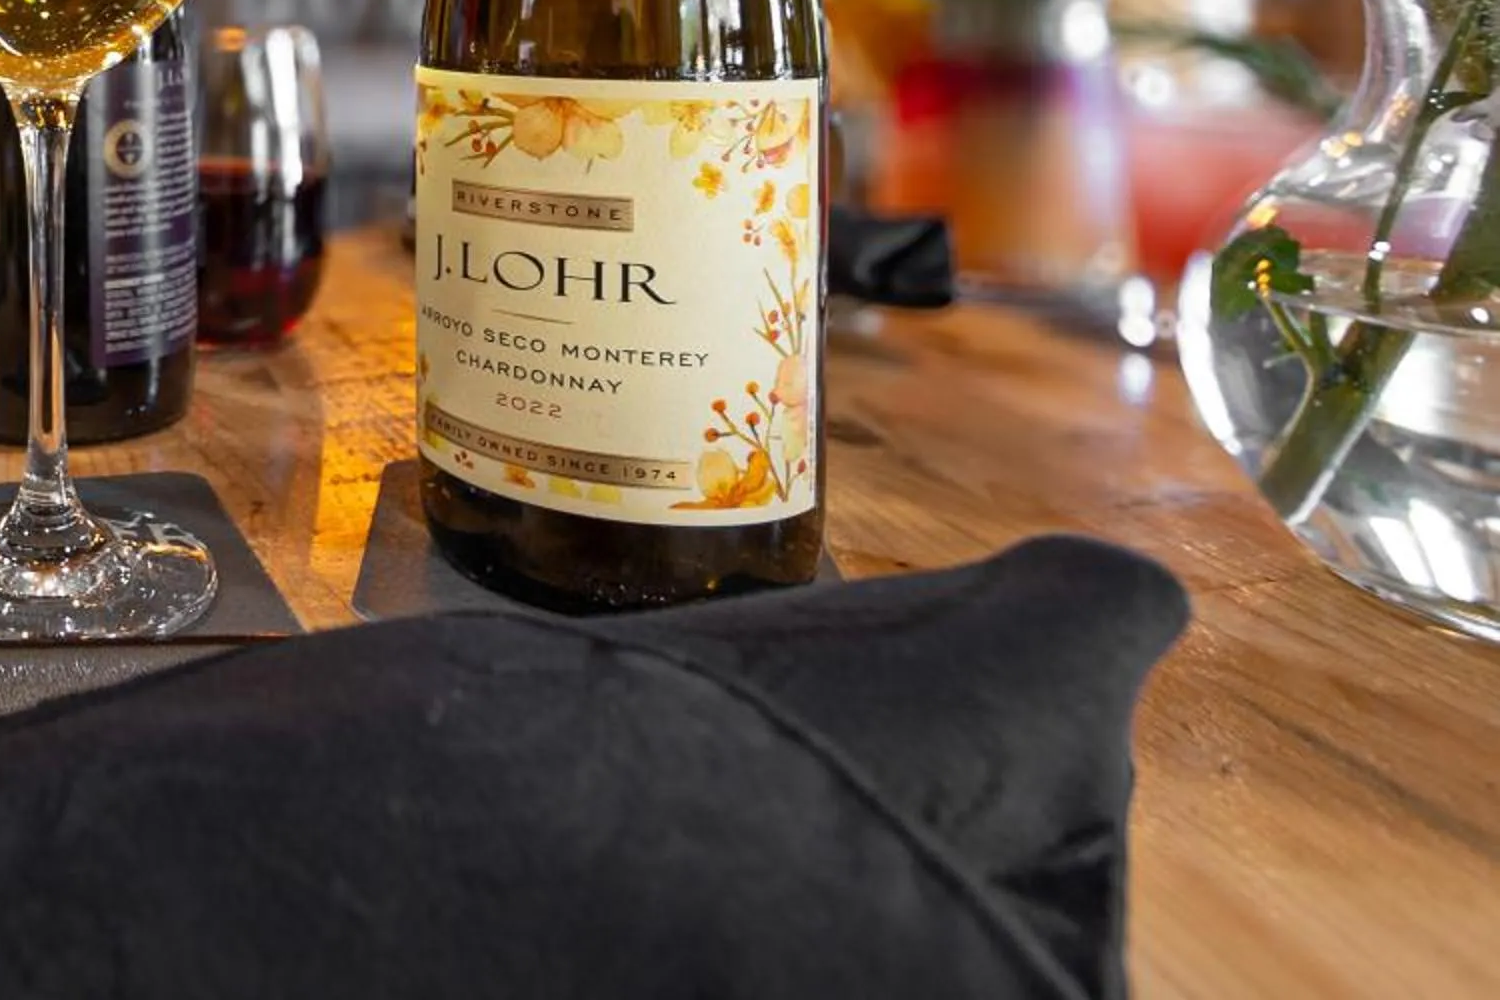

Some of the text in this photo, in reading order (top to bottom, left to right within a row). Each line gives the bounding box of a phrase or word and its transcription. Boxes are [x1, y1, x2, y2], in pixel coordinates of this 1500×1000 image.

[457, 190, 623, 221] RIVERSTONE
[421, 306, 710, 367] ARROYO SECO MONTEREY
[456, 349, 623, 395] CHARDONNAY
[496, 393, 563, 419] 2022
[429, 413, 678, 482] FAMILY OWNED SINCE 1974
